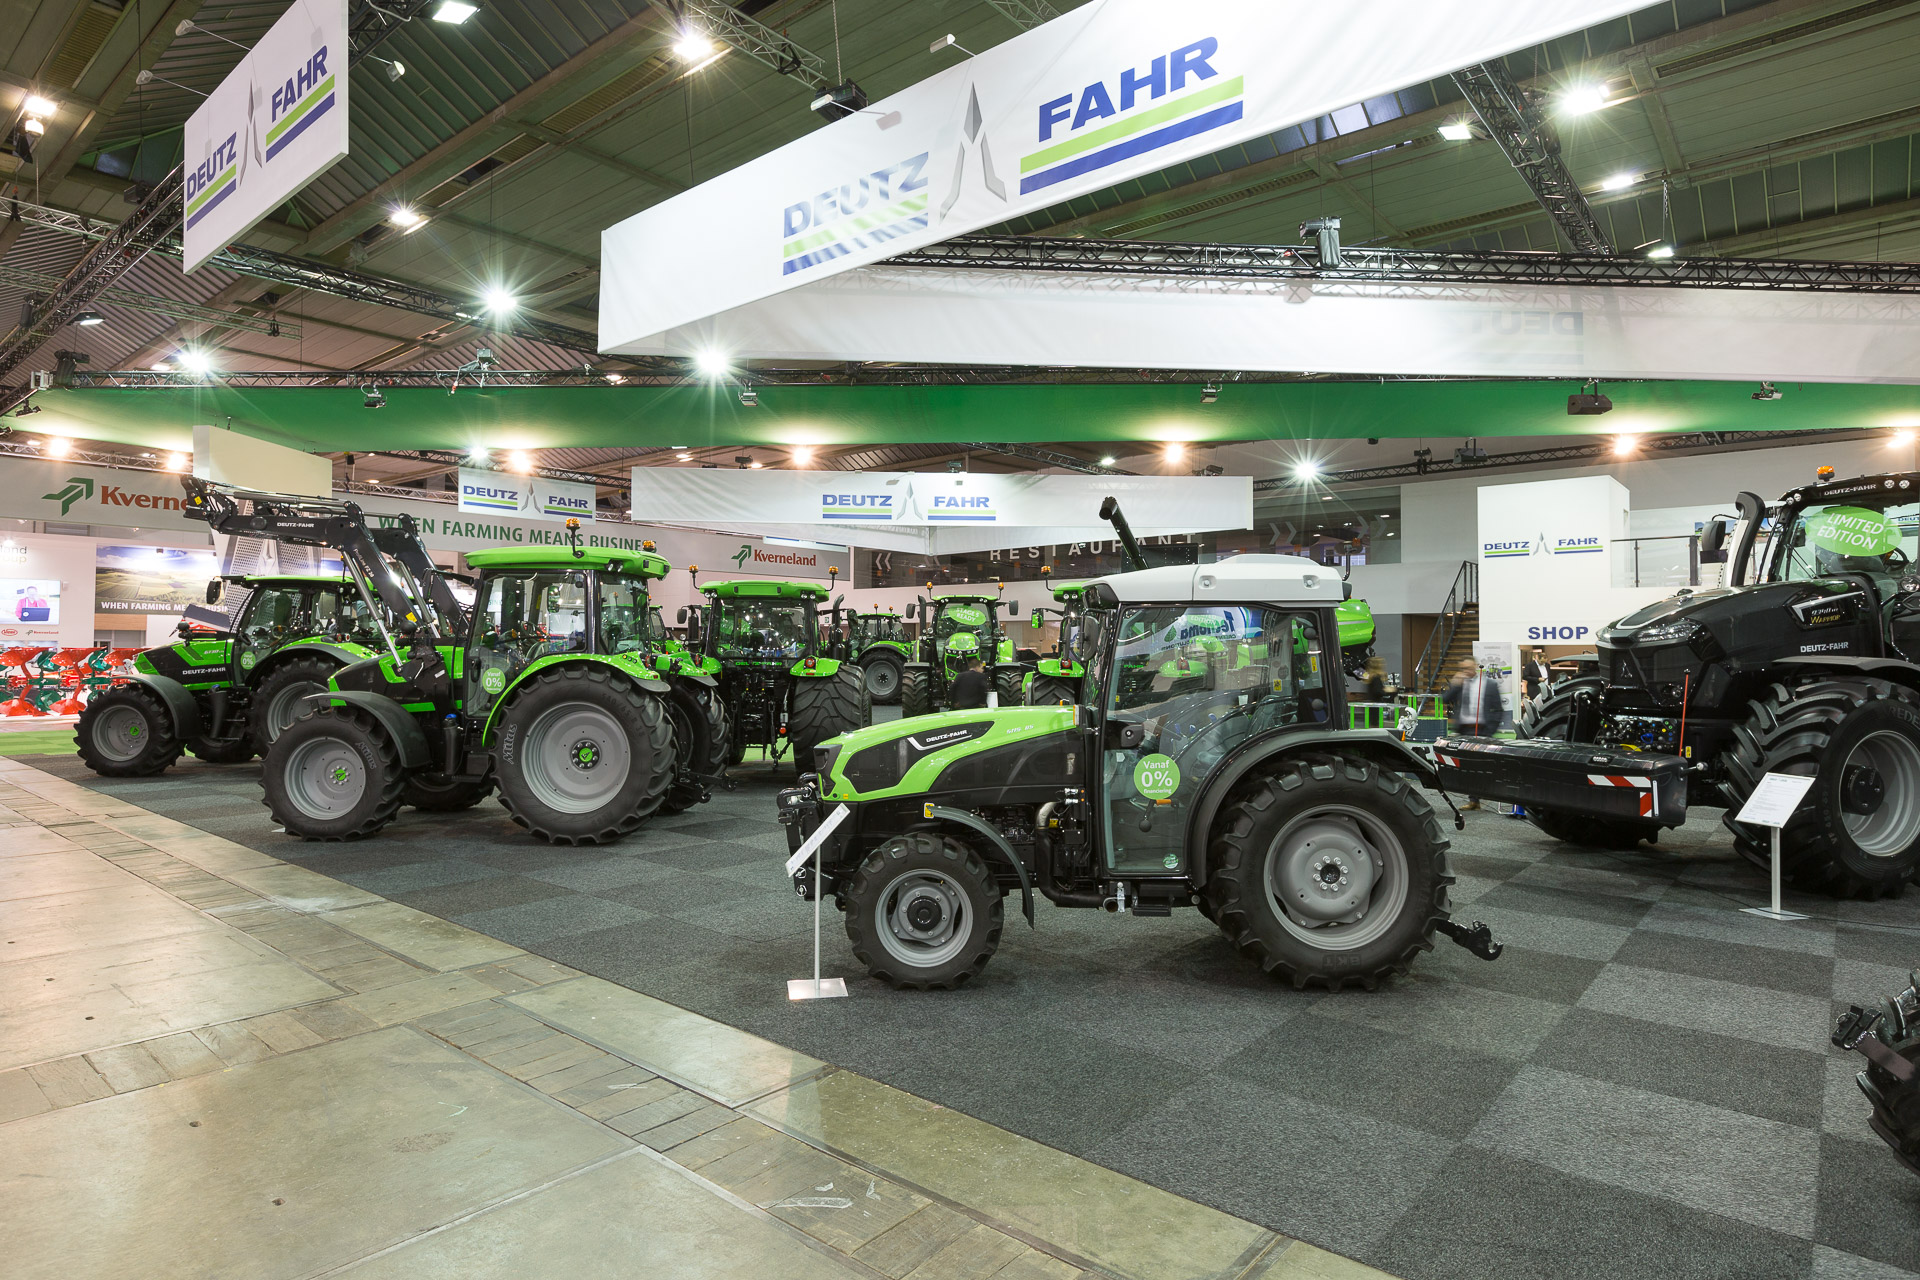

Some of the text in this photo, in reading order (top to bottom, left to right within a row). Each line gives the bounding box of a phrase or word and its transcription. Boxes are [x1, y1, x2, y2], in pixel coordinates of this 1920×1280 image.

[187, 45, 328, 202] DEUTZ FAHR
[783, 36, 1218, 238] DEUTZ FAHR
[463, 485, 588, 509] DEUTZ FAHR
[1824, 484, 1877, 496] DEUTZ-FAHR
[822, 494, 990, 508] DEUTZ FAHR
[1827, 512, 1884, 535] LIMITED
[443, 520, 523, 542] FARMING
[529, 528, 584, 547] MEANS
[1817, 525, 1878, 550] EDITION
[1484, 537, 1598, 551] DEUTZ FAHR
[754, 549, 816, 567] Kverneland
[101, 601, 128, 610] WHEN
[130, 602, 171, 611] FARMING
[956, 612, 977, 622] READY
[1528, 626, 1589, 640] SHOP
[1800, 642, 1849, 653] DEUTZ-FAHR
[182, 667, 226, 675] DEUTZ-FAHR
[485, 677, 502, 688] 0%
[926, 730, 968, 743] DEUTZ-FAHR
[1143, 760, 1170, 769] Vanaf
[1141, 771, 1173, 788] 0%
